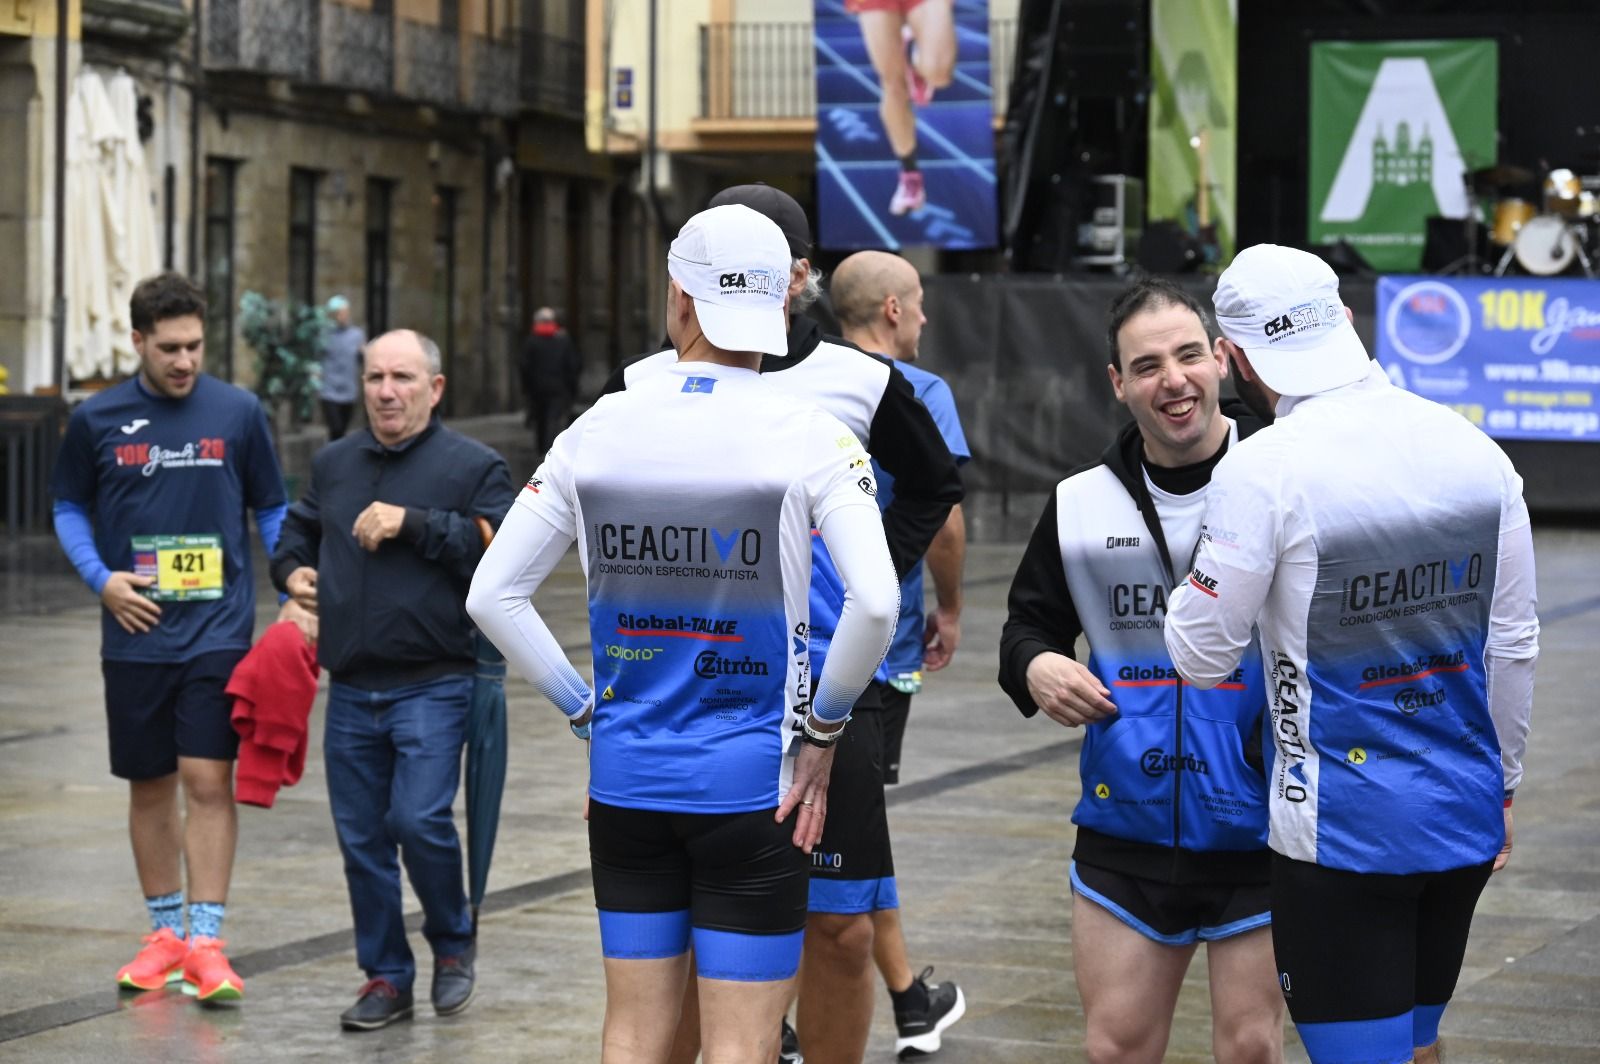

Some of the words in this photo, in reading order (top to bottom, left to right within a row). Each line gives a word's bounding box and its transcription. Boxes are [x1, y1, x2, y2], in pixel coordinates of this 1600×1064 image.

[601, 523, 761, 566] CEACTIVO
[171, 553, 204, 573] 421
[600, 563, 652, 576] CONDICIÓN
[656, 566, 710, 579] ESPECTRO
[713, 569, 759, 581] AUTISTA
[1350, 553, 1482, 611] CEACTIVO
[1114, 584, 1168, 617] CEA
[1340, 608, 1401, 628] CONDICIÓN
[1403, 600, 1447, 616] ESPECTRO
[1448, 592, 1478, 608] AUTISTA
[618, 612, 738, 634] Global-TALKE
[1110, 619, 1160, 631] CONDICIÓN
[812, 852, 842, 868] TIVO
